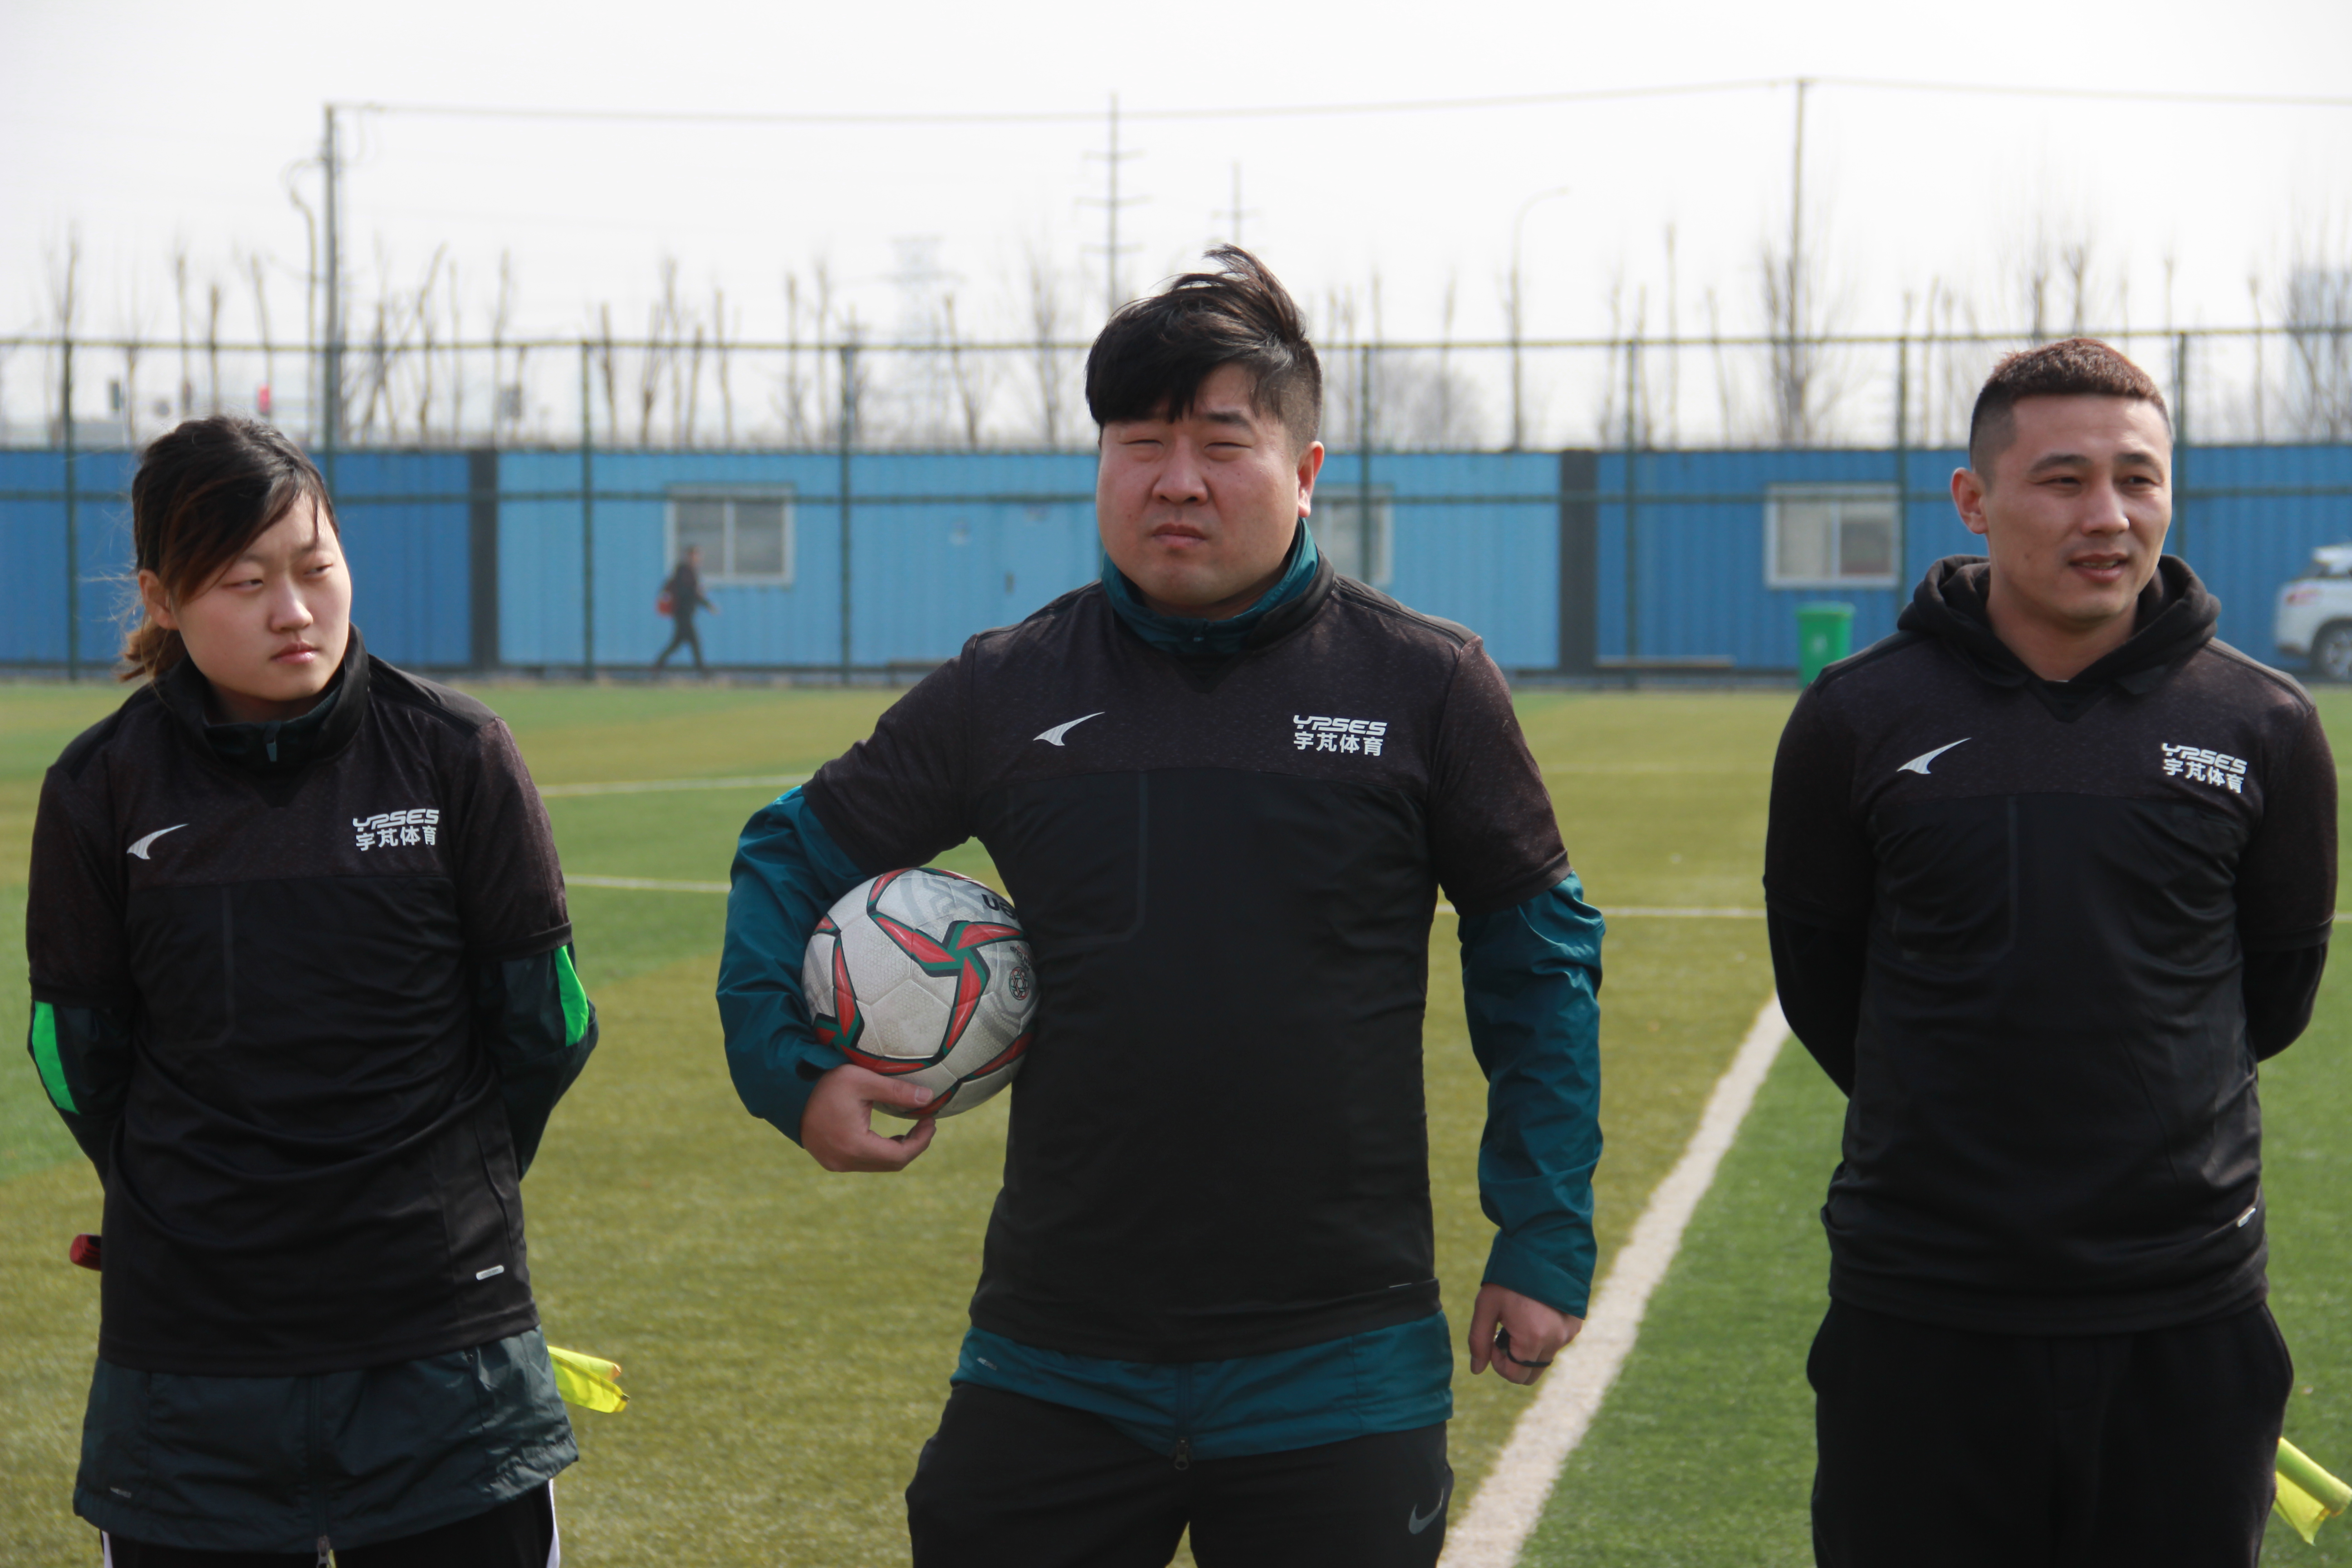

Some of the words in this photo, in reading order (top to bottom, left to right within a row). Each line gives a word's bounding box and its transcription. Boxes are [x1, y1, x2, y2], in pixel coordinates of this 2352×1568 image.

[1293, 715, 1387, 736] YPSES
[1294, 731, 1383, 756] 宇芃体育
[2161, 743, 2247, 774] YPSES
[2163, 758, 2244, 794] 宇芃体育
[353, 808, 439, 832] YPSES
[356, 825, 436, 851] 宇芃体育
